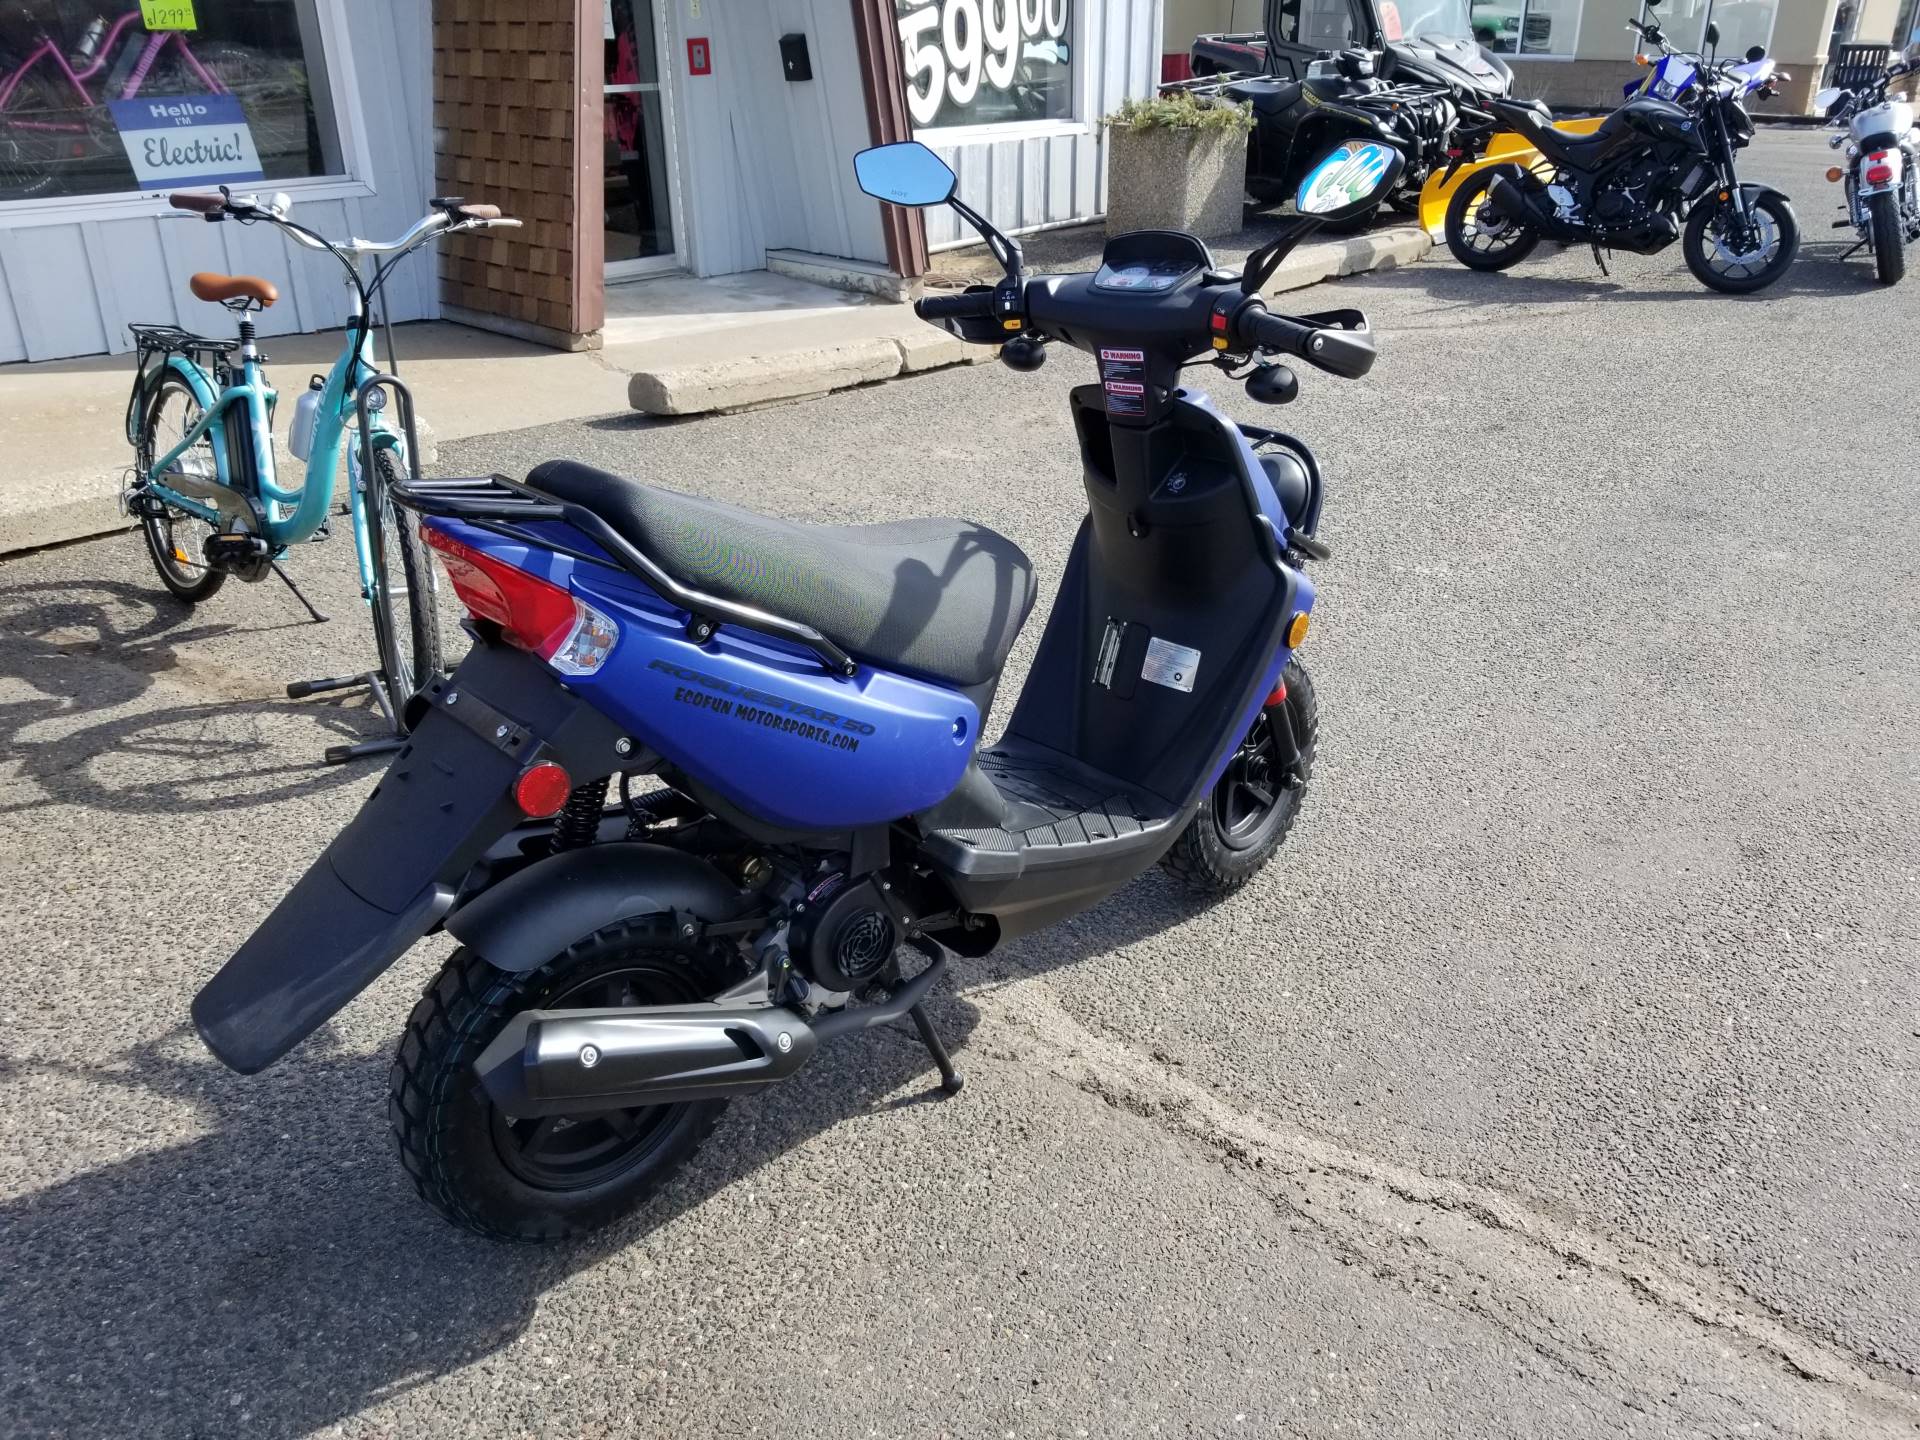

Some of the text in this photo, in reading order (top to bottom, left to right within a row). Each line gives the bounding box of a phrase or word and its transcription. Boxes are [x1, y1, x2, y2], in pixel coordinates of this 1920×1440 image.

[149, 103, 207, 117] Hello
[175, 117, 192, 125] I'M
[143, 133, 242, 167] Electric!
[1110, 352, 1141, 360] WARNING
[647, 659, 876, 736] ROGUESTAR 50
[674, 687, 859, 752] ECOFUN MOTORSPORTS.COM
